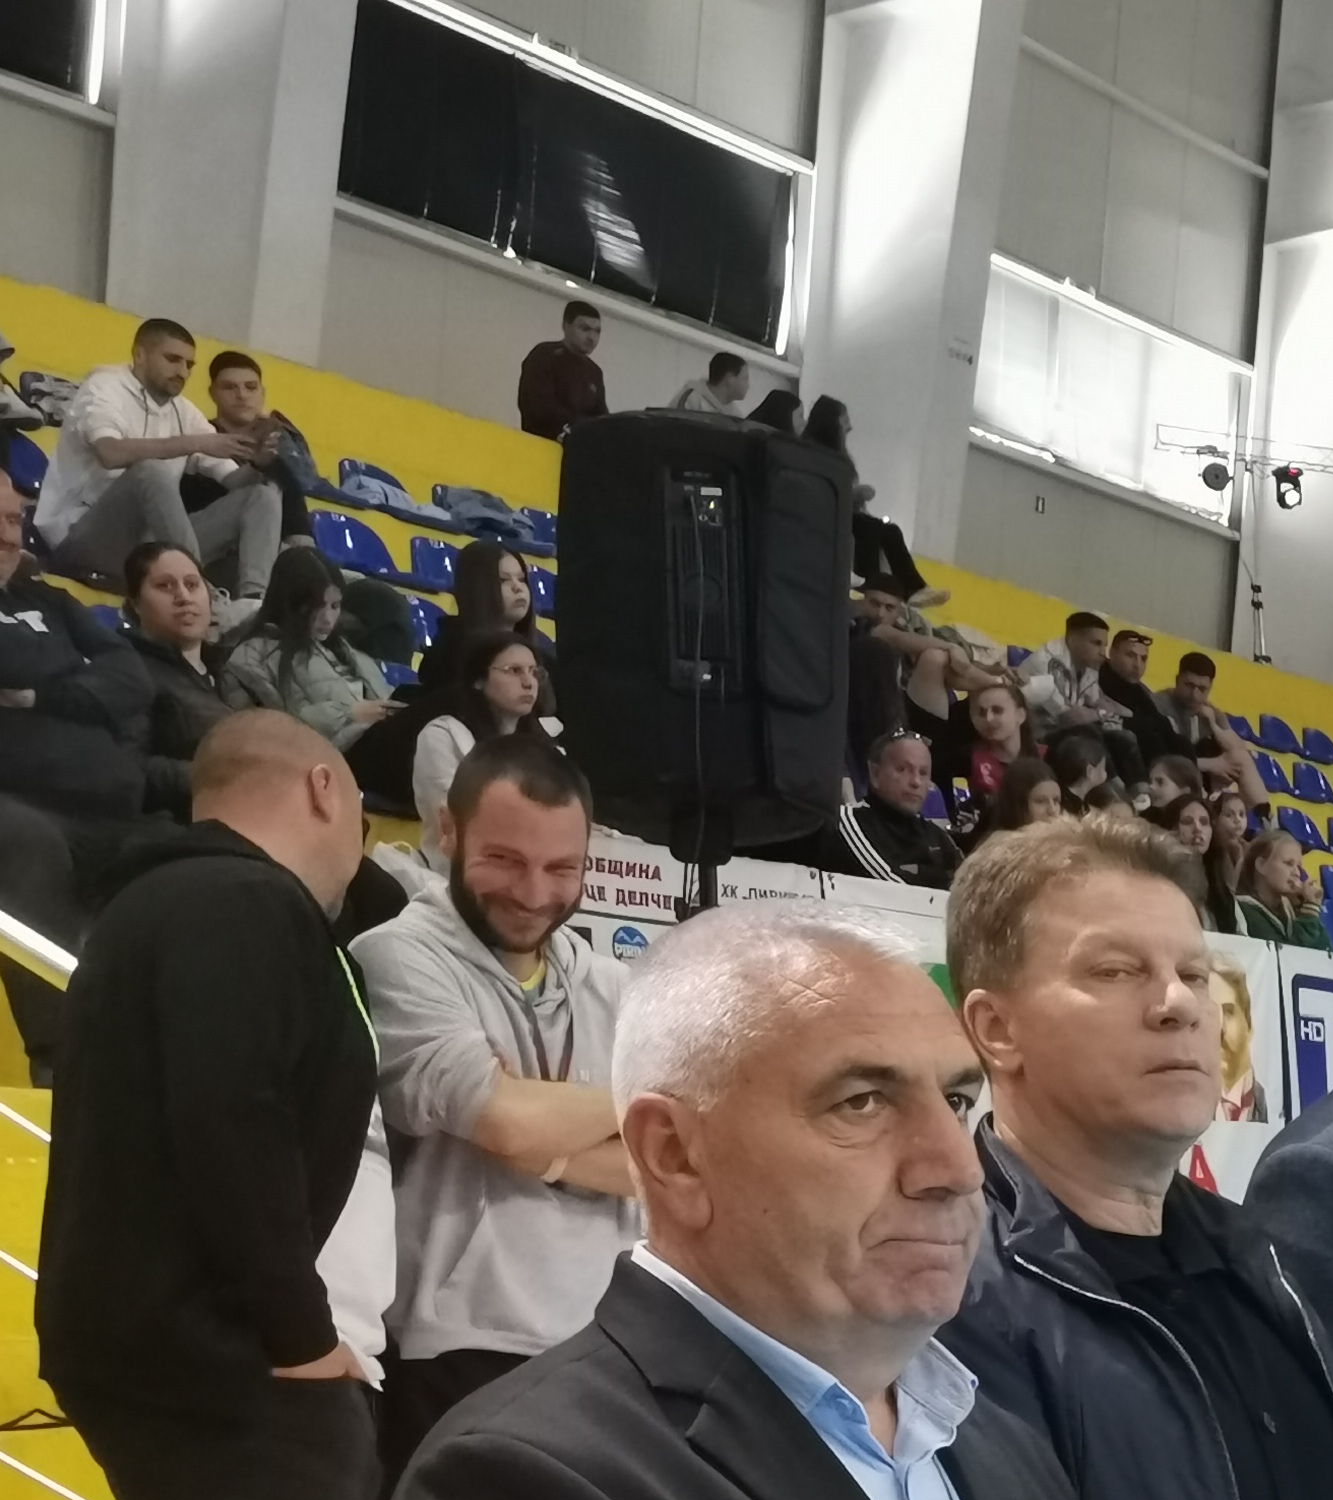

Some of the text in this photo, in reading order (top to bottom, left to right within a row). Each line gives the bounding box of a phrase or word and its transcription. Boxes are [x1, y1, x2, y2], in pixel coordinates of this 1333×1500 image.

[584, 855, 662, 882] ОБЩИНА
[583, 883, 673, 911] ЦЕ ДЕЛЧЕ
[1300, 1020, 1325, 1042] HD
